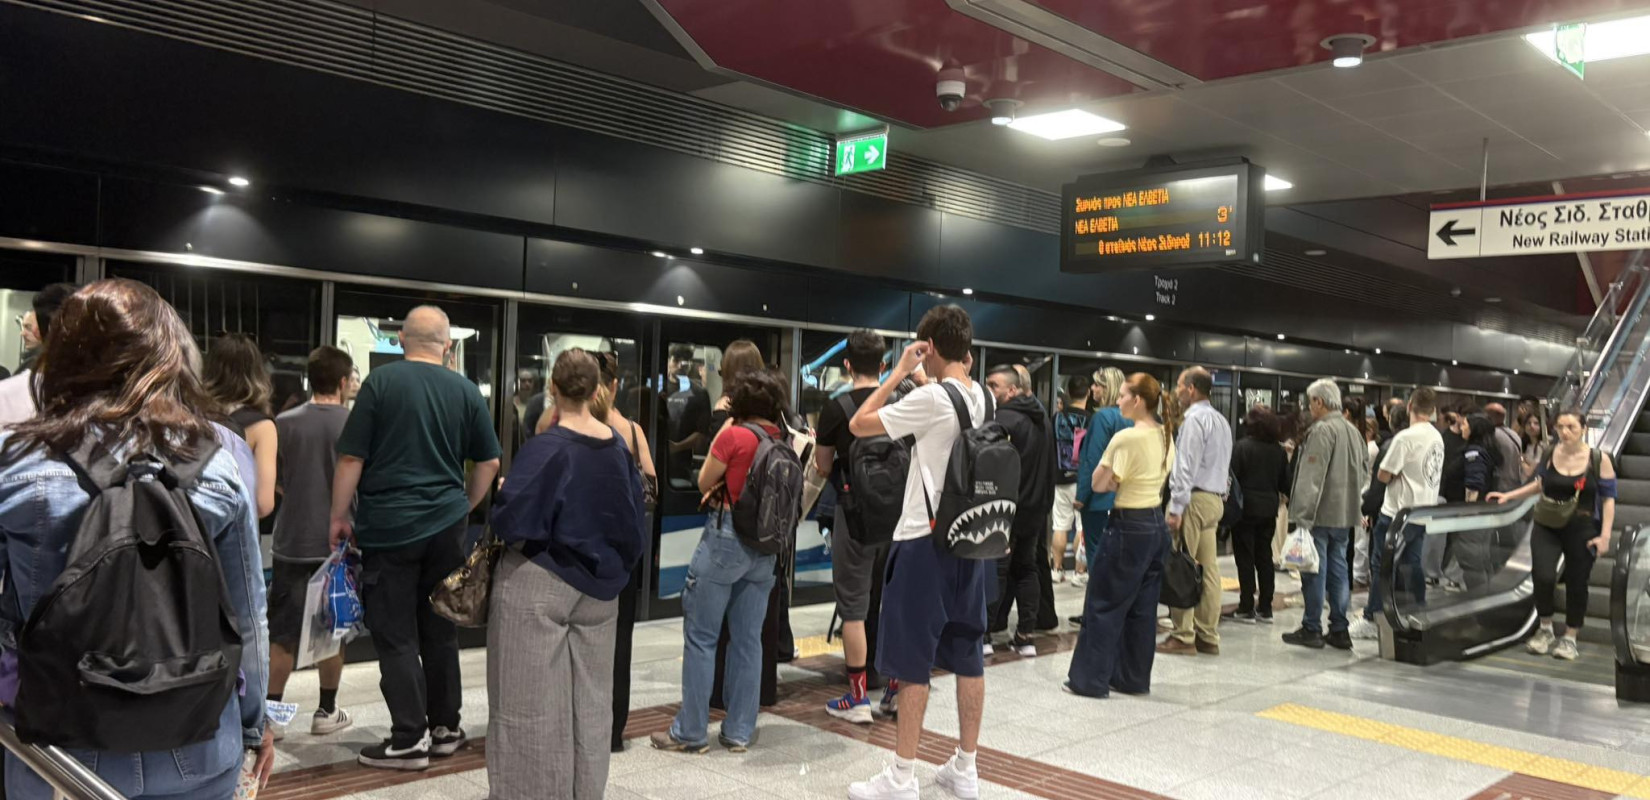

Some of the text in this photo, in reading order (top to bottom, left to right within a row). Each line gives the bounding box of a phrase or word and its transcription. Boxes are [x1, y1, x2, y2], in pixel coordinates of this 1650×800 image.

[1500, 199, 1650, 230] Νέος Σιδ. Σταθ
[1198, 230, 1231, 248] 11:12
[1513, 234, 1545, 248] New
[1549, 231, 1610, 247] Railway
[1155, 291, 1171, 305] Track
